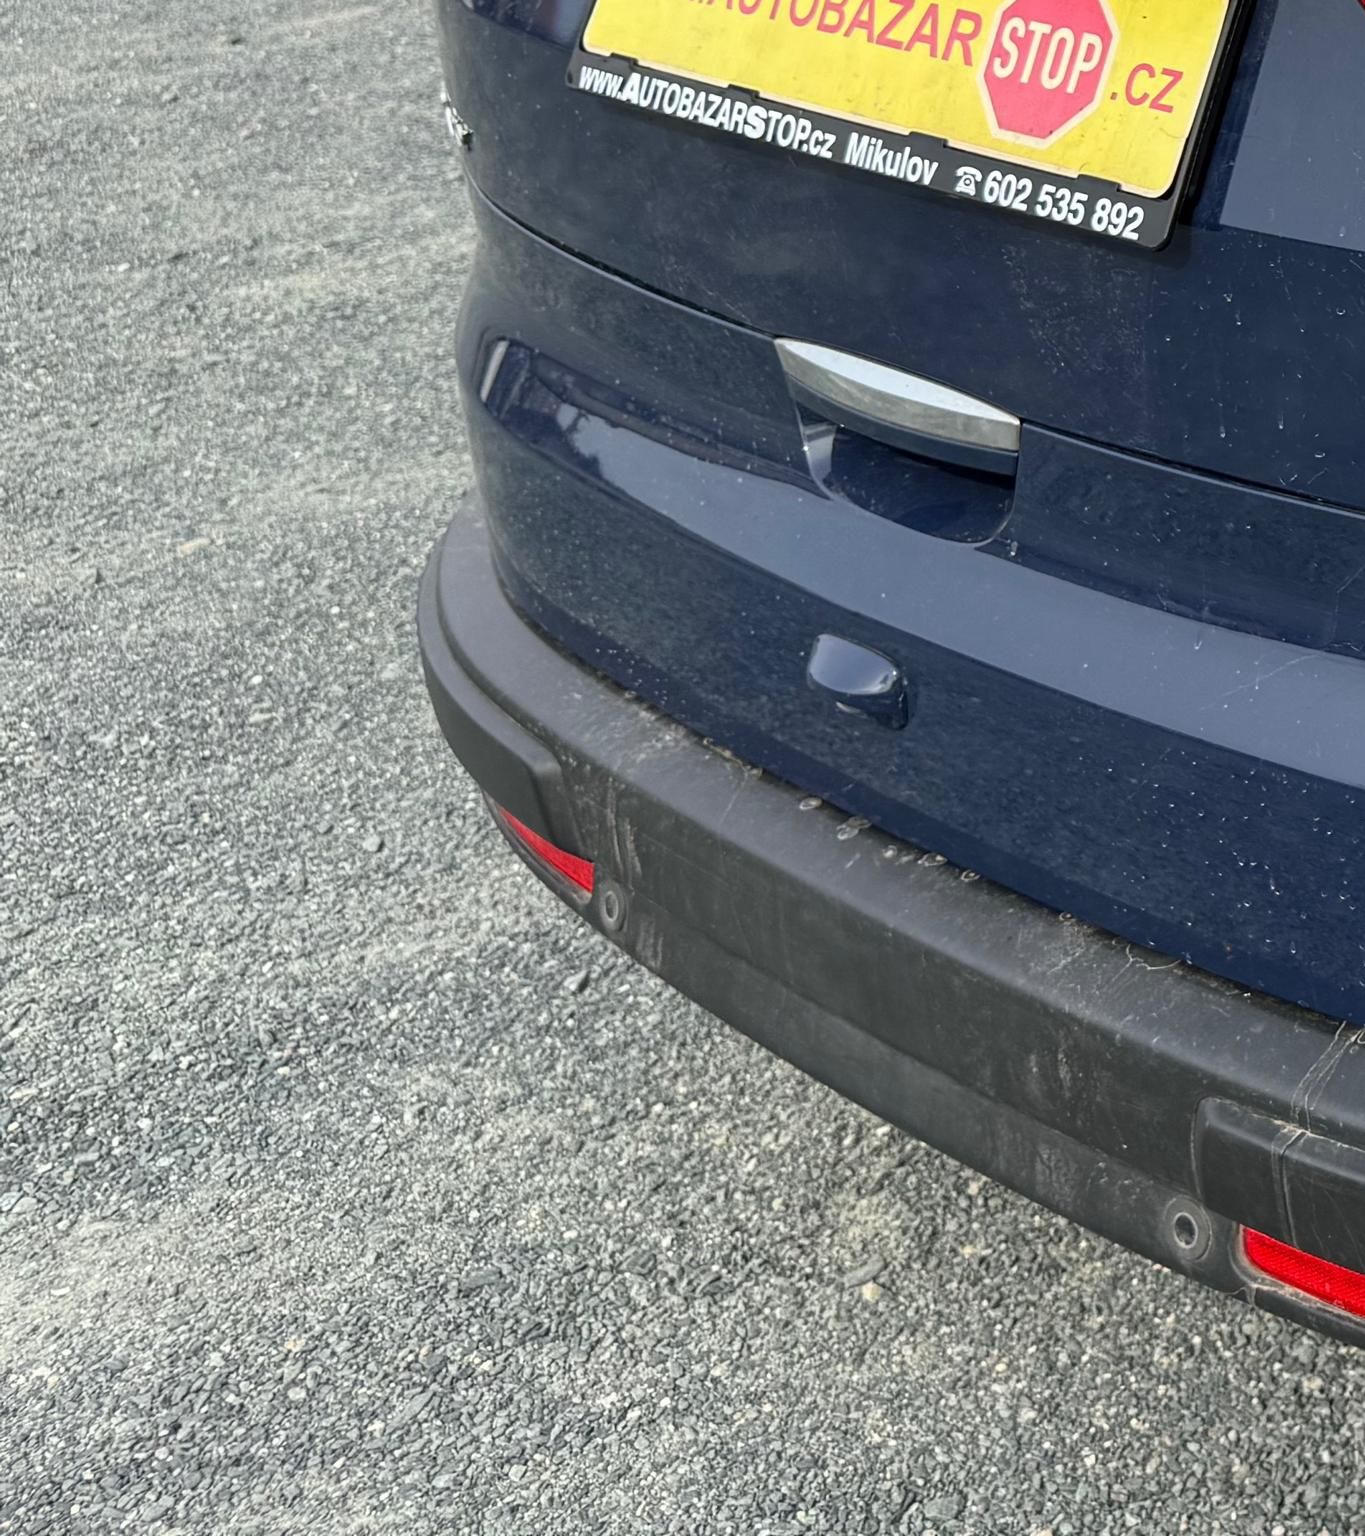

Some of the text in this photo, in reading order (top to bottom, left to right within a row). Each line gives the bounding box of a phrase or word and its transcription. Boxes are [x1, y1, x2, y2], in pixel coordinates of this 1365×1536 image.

[844, 132, 939, 186] Mikulov
[983, 170, 1032, 212] 602
[1034, 183, 1088, 226] 535
[1090, 197, 1144, 241] 892
